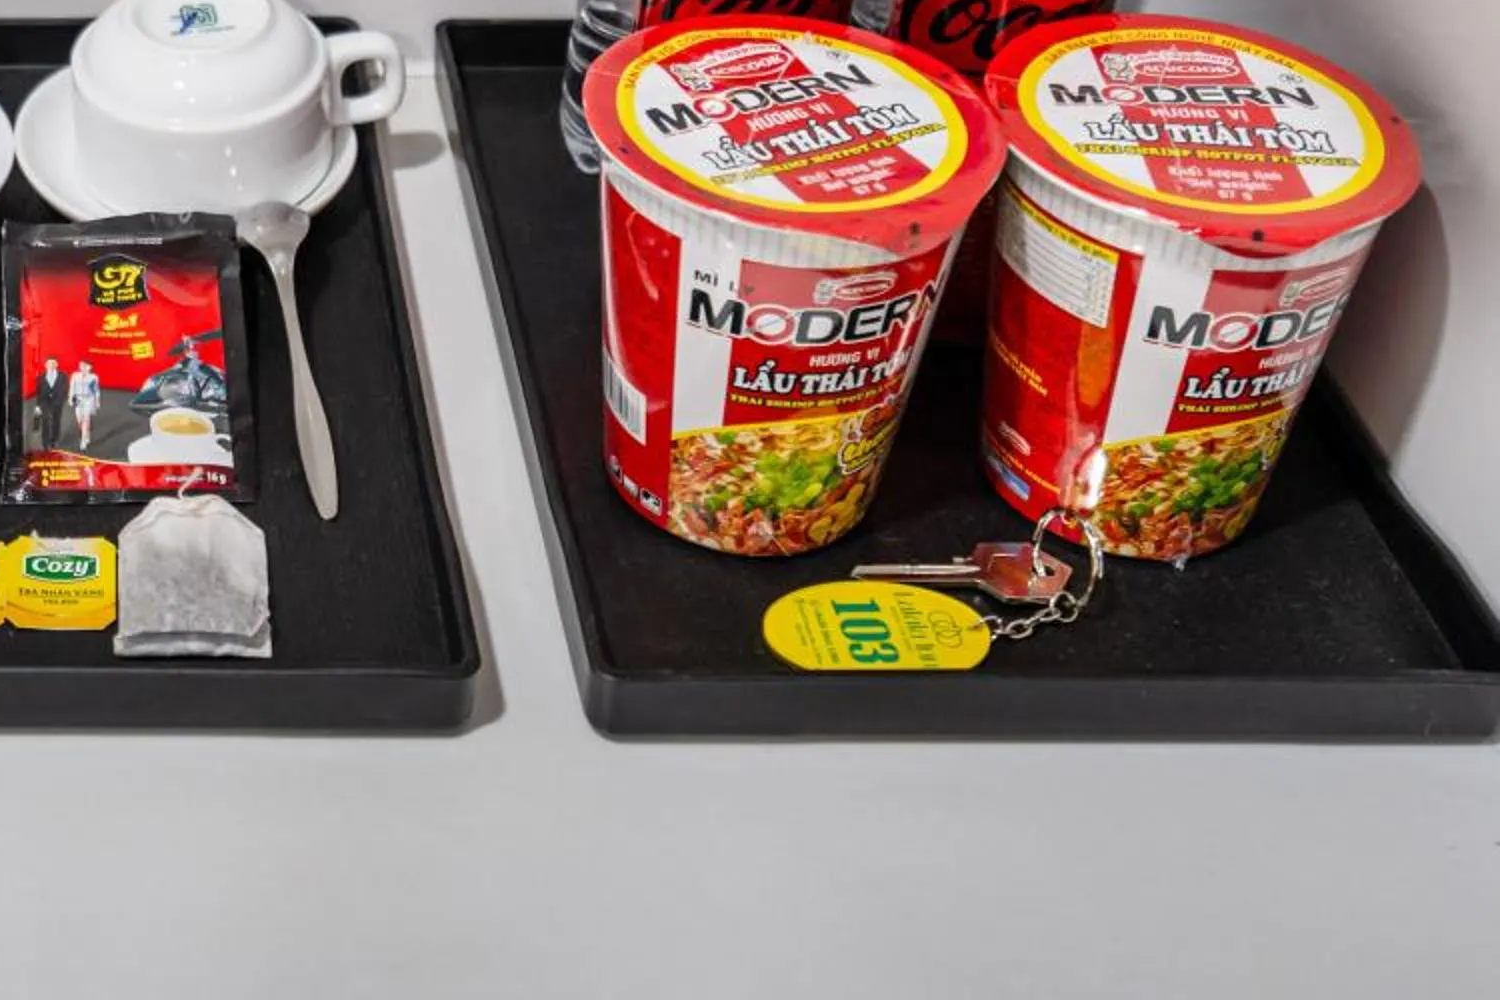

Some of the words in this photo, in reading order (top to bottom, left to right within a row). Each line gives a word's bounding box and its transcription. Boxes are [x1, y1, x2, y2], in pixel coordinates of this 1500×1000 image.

[645, 63, 875, 136] MODERN
[1048, 82, 1316, 109] MODERN
[770, 119, 852, 155] THÁI
[846, 102, 921, 139] TÔM
[1084, 113, 1162, 144] LẨU
[1160, 119, 1254, 148] THÁI
[1254, 121, 1336, 155] TÔM
[93, 264, 144, 289] G7
[732, 359, 797, 394] LẨU
[801, 364, 866, 395] THÁI
[1184, 366, 1247, 399] LẨU
[30, 556, 90, 577] Cozy
[830, 597, 900, 664] 103
